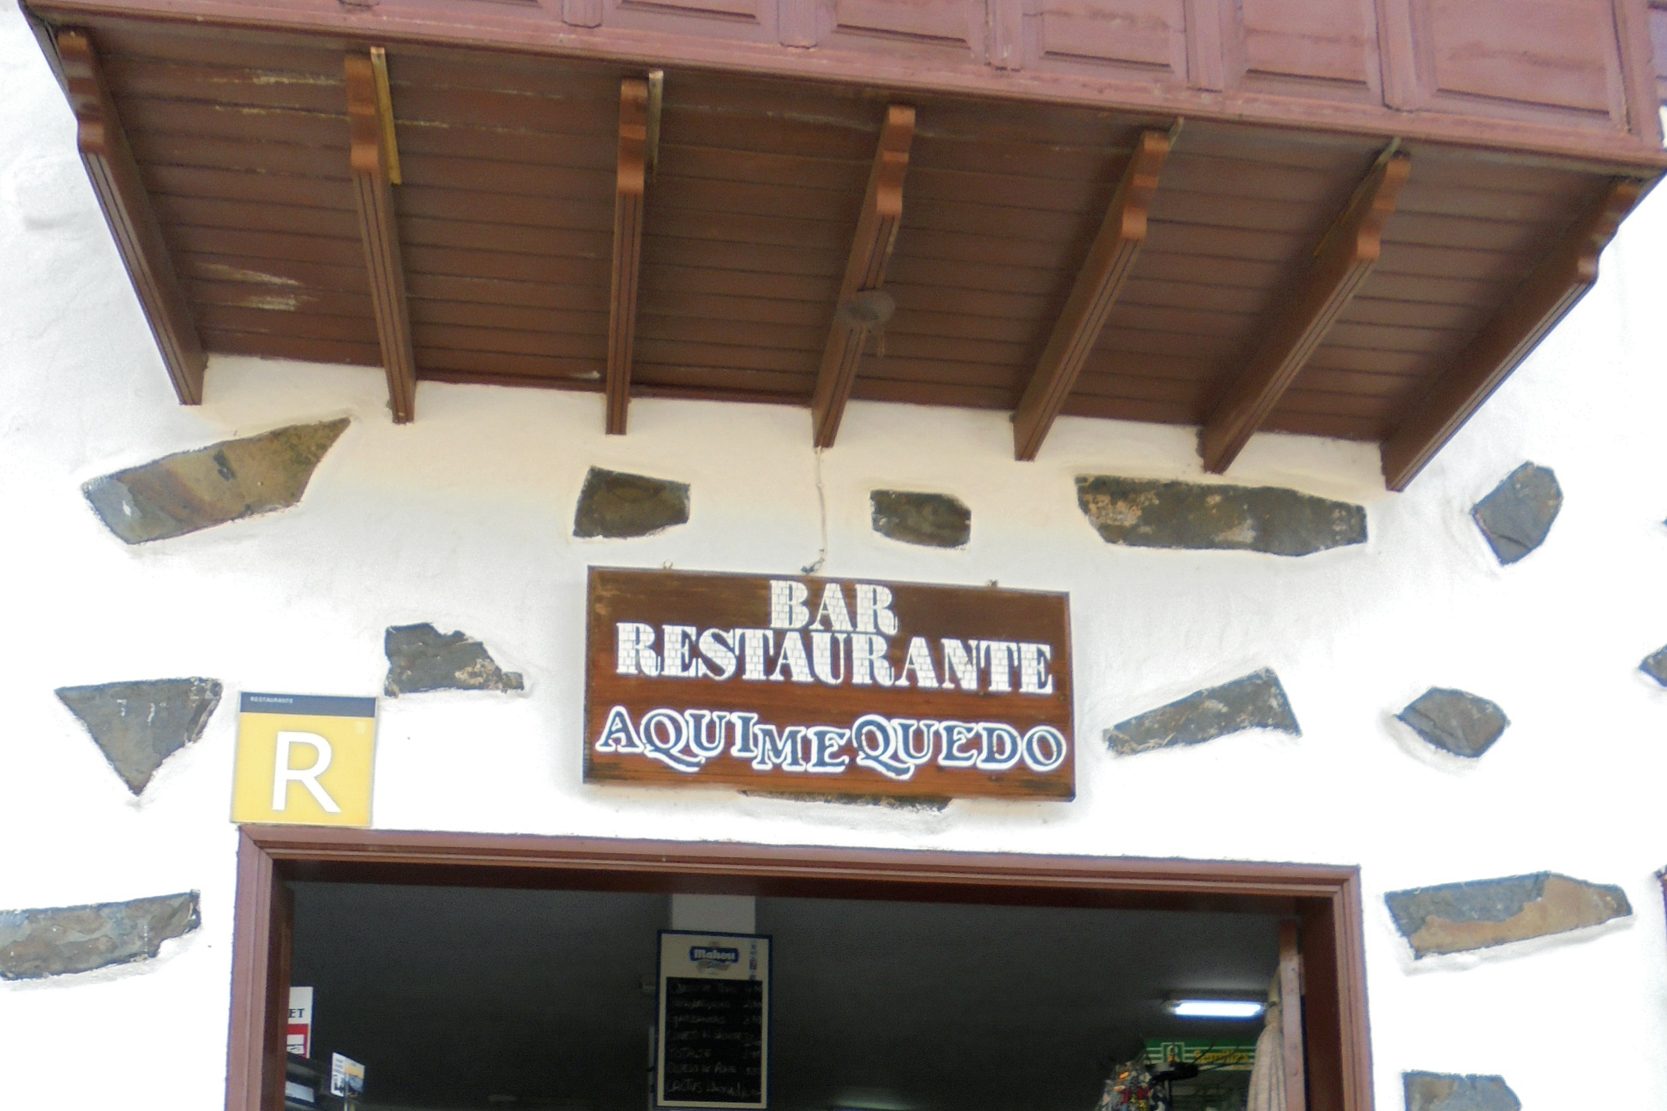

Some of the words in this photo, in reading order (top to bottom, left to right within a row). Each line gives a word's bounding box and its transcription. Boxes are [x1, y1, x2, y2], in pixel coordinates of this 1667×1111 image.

[769, 579, 899, 636] BAR
[615, 621, 1054, 695] RESTAURANTE
[250, 696, 294, 705] RESTAURANTE
[271, 730, 342, 814] R
